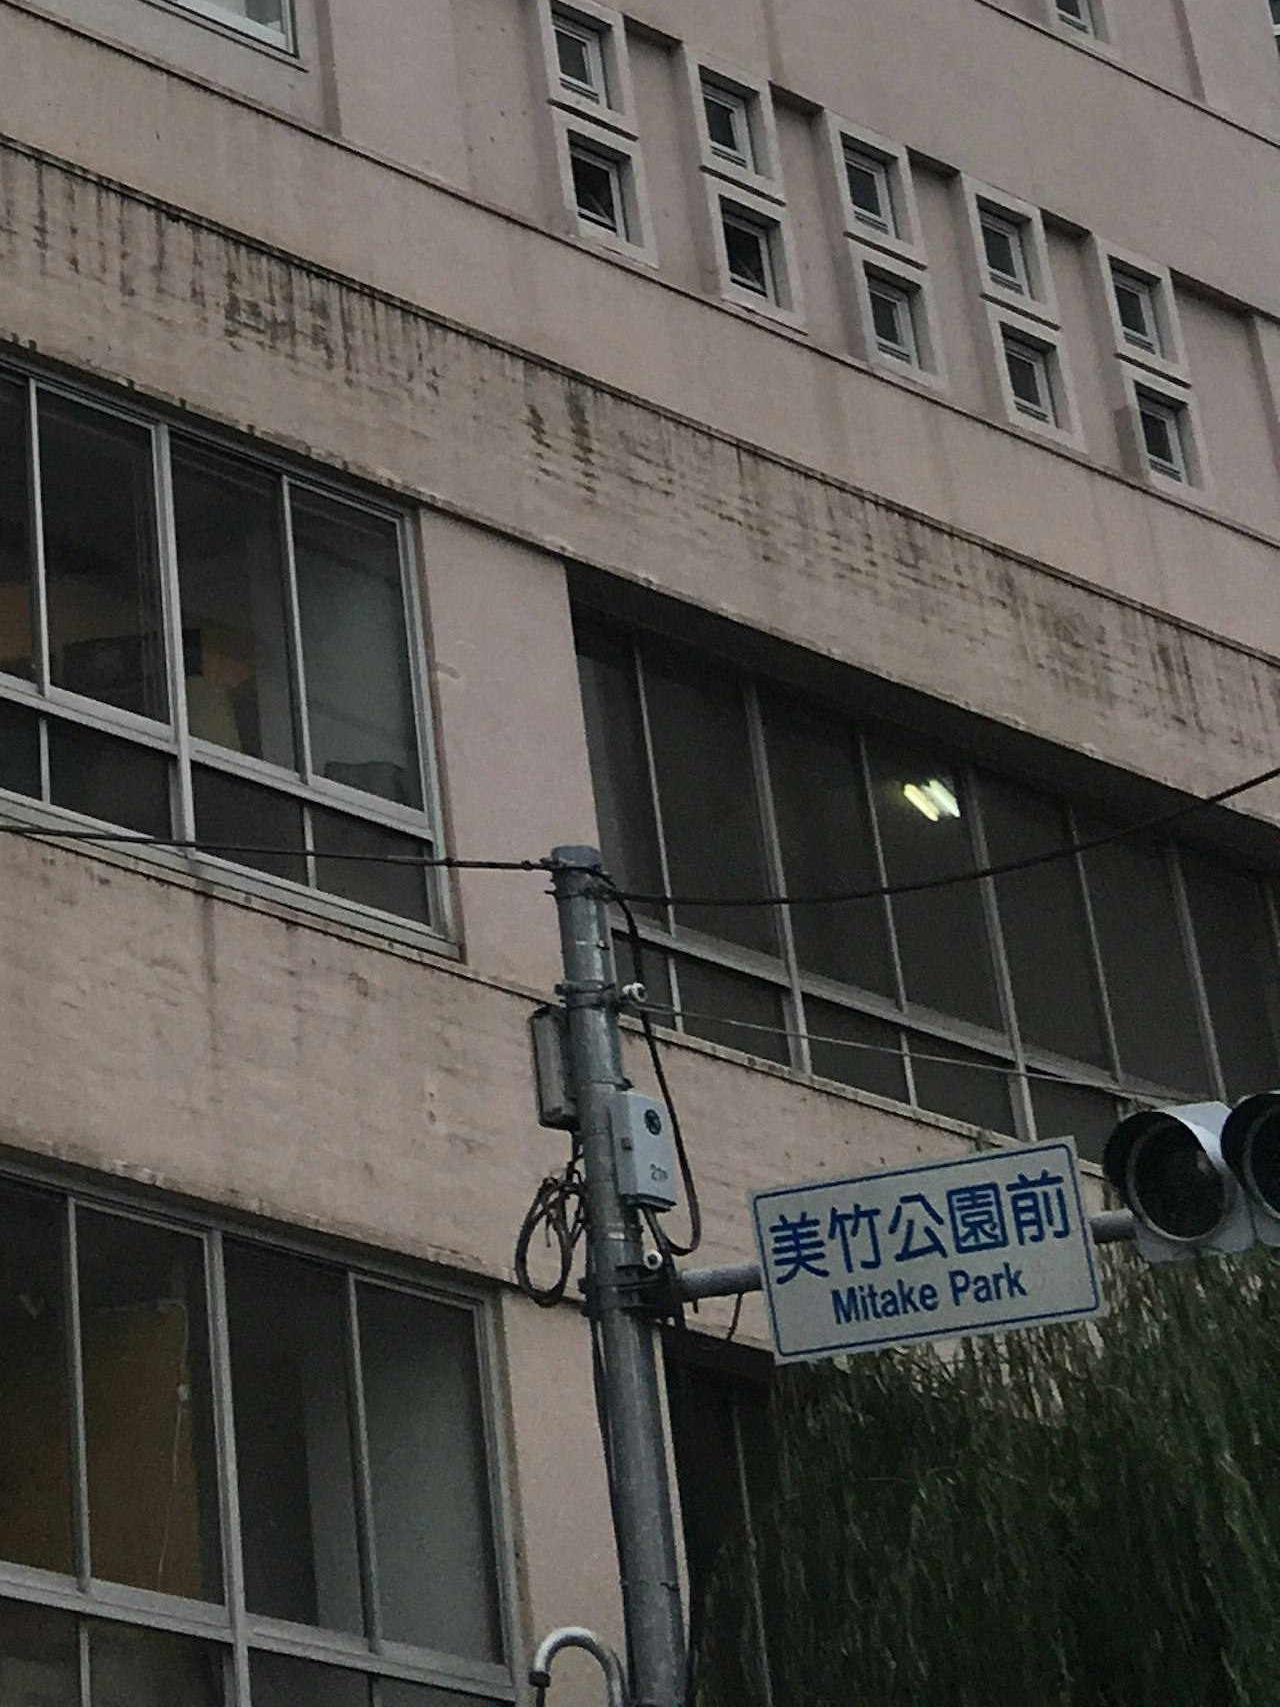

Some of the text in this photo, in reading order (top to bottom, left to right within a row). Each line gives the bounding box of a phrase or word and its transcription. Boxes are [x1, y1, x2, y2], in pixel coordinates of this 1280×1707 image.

[769, 1169, 1069, 1284] 美竹公園前
[831, 1262, 1028, 1324] Mitake Park
